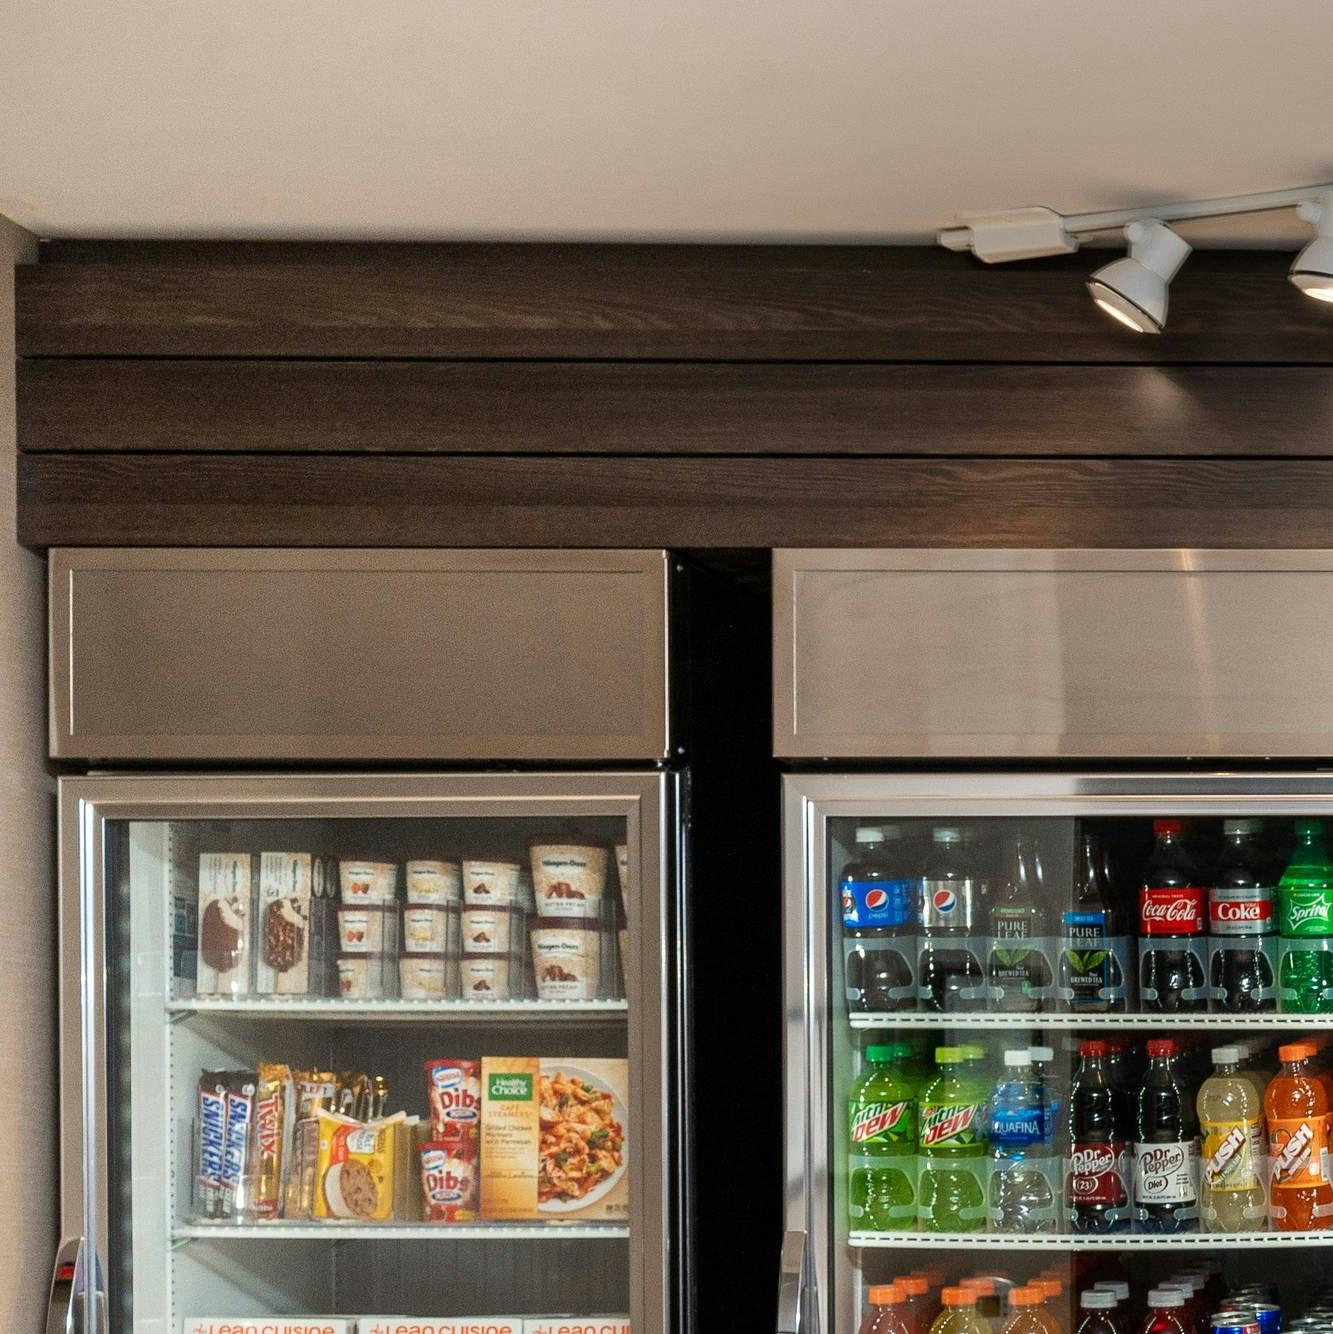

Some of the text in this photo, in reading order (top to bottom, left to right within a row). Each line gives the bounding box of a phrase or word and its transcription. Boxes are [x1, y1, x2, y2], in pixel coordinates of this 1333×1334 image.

[1142, 898, 1197, 922] Coca-Cola
[1217, 901, 1260, 920] Coke
[1290, 902, 1329, 920] Sprite
[1069, 927, 1101, 937] PURE
[1073, 1153, 1113, 1176] Pepper
[1141, 1153, 1182, 1176] Pepper
[426, 1169, 470, 1192] Dibs
[1147, 1178, 1163, 1190] Diet
